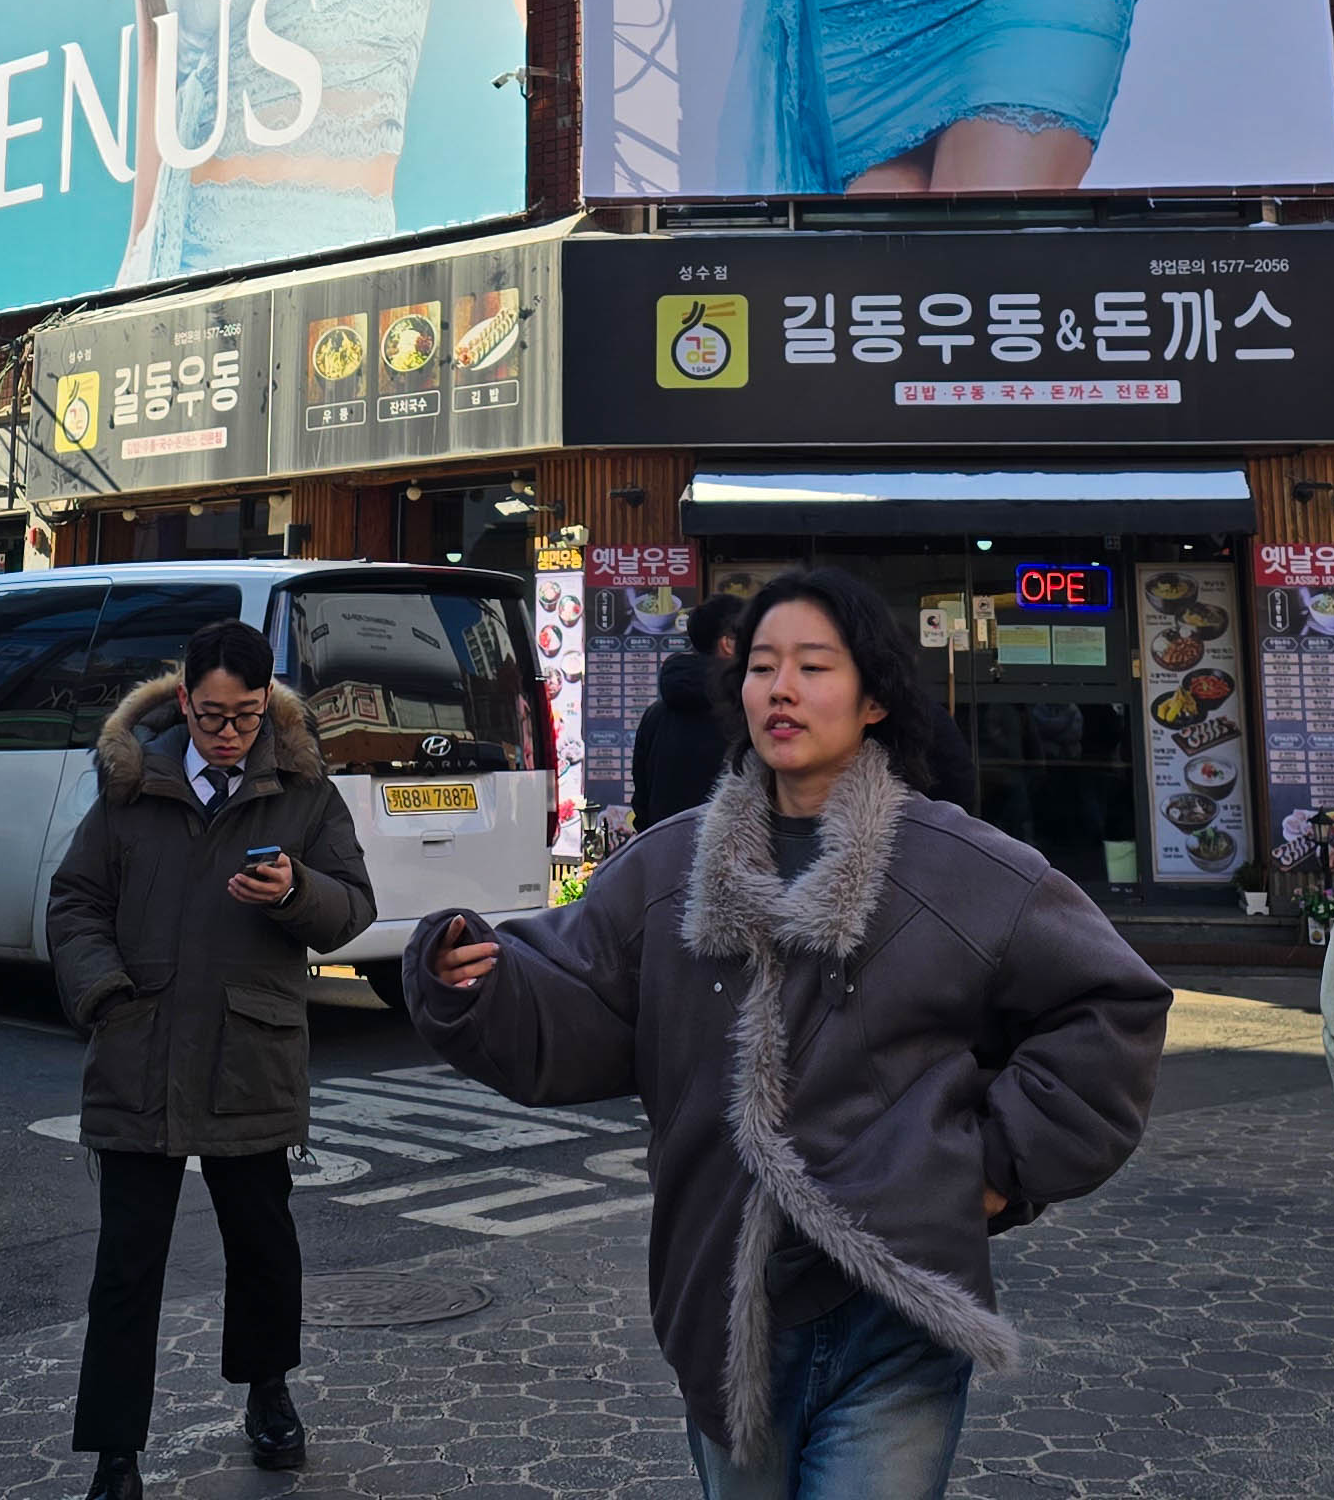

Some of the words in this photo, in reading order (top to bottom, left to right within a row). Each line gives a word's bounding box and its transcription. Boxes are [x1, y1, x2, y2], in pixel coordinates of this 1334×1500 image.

[679, 265, 728, 281] 성수점
[1149, 259, 1205, 276] 창업문의
[1211, 258, 1290, 273] 1577-2056
[783, 288, 1295, 365] 길동우동&돈까스
[114, 349, 240, 426] 길동우동
[1116, 382, 1170, 400] 전문점
[390, 396, 428, 416] 잔치국수
[592, 547, 691, 575] 옛날우동
[434, 788, 469, 808] 7887
